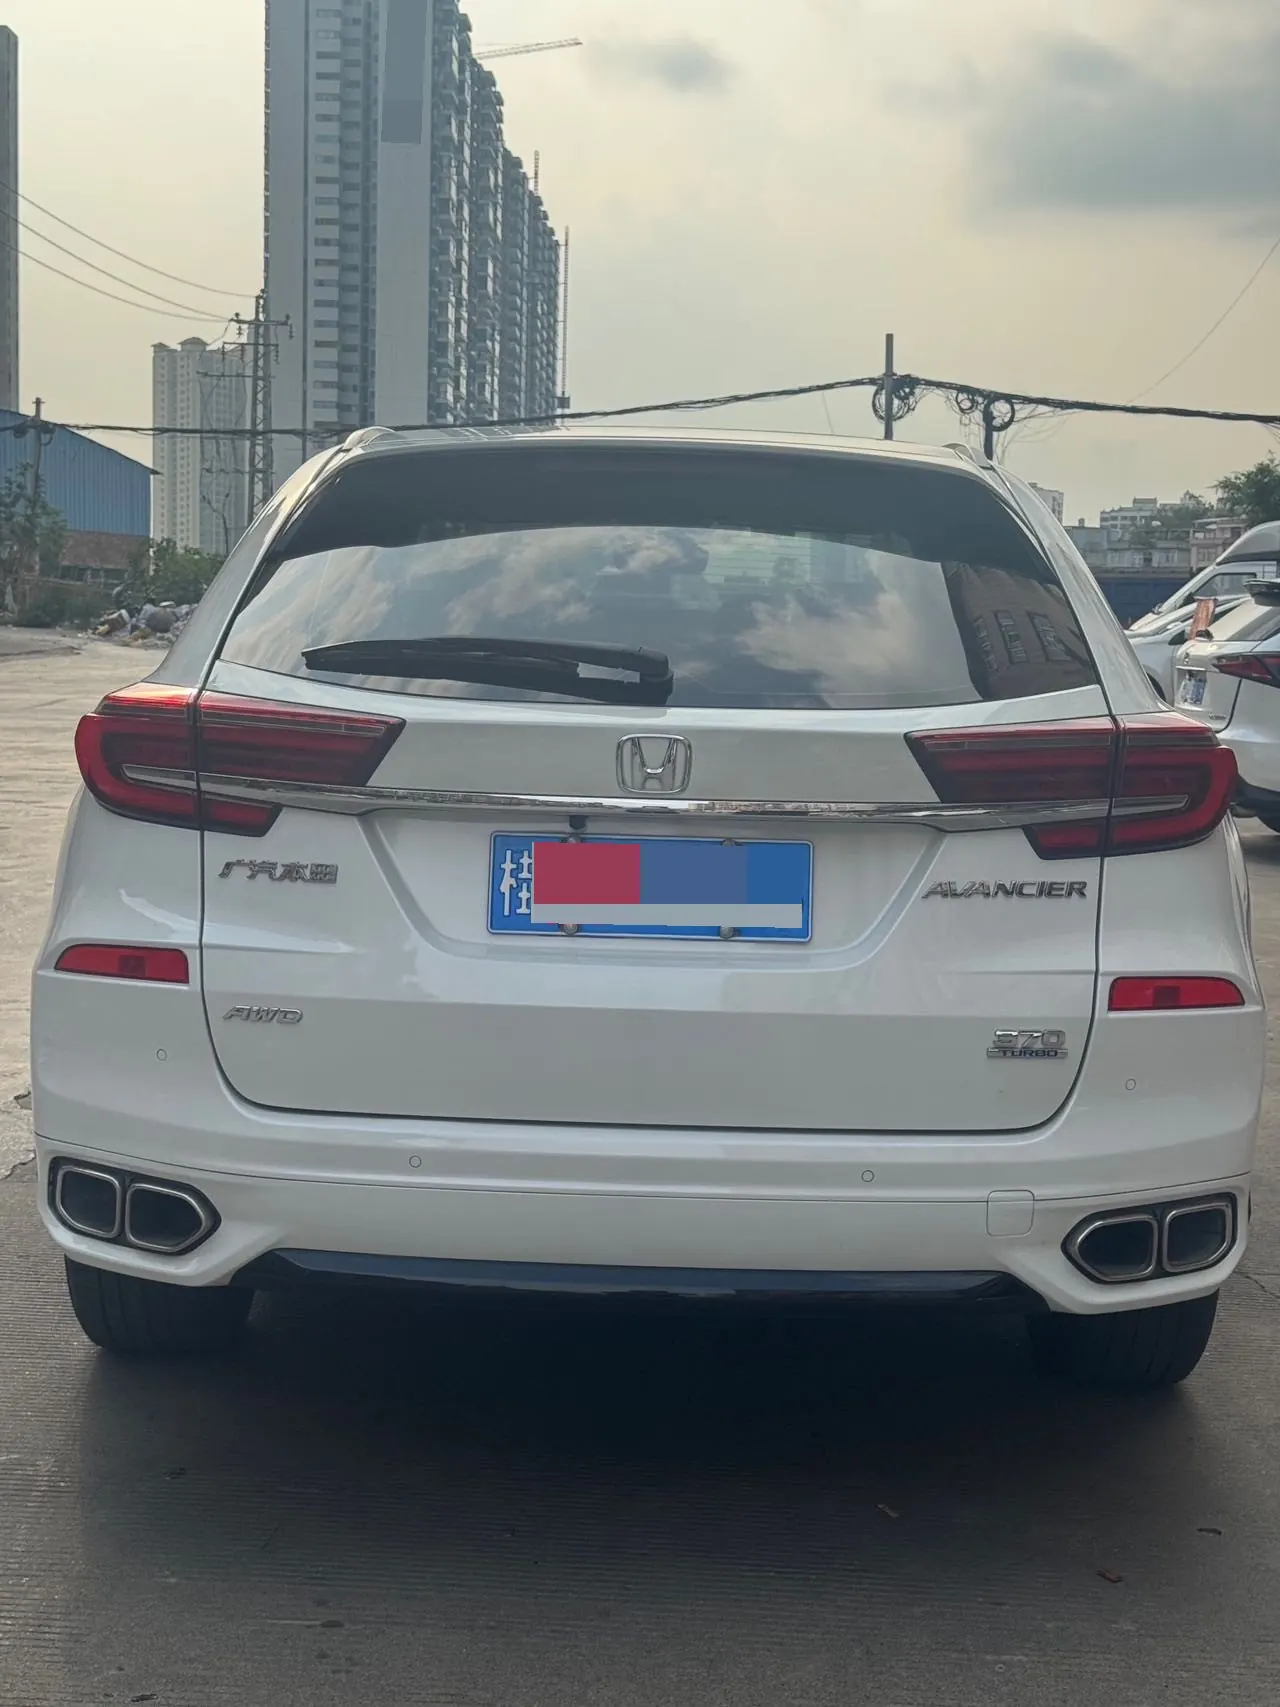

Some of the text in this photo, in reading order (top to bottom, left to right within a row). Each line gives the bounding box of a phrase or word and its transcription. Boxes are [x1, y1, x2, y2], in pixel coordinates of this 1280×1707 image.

[218, 859, 339, 884] 广汽本田
[921, 880, 1088, 899] AVANCIER
[223, 1004, 304, 1024] AWD
[1001, 1048, 1059, 1058] TURBO
